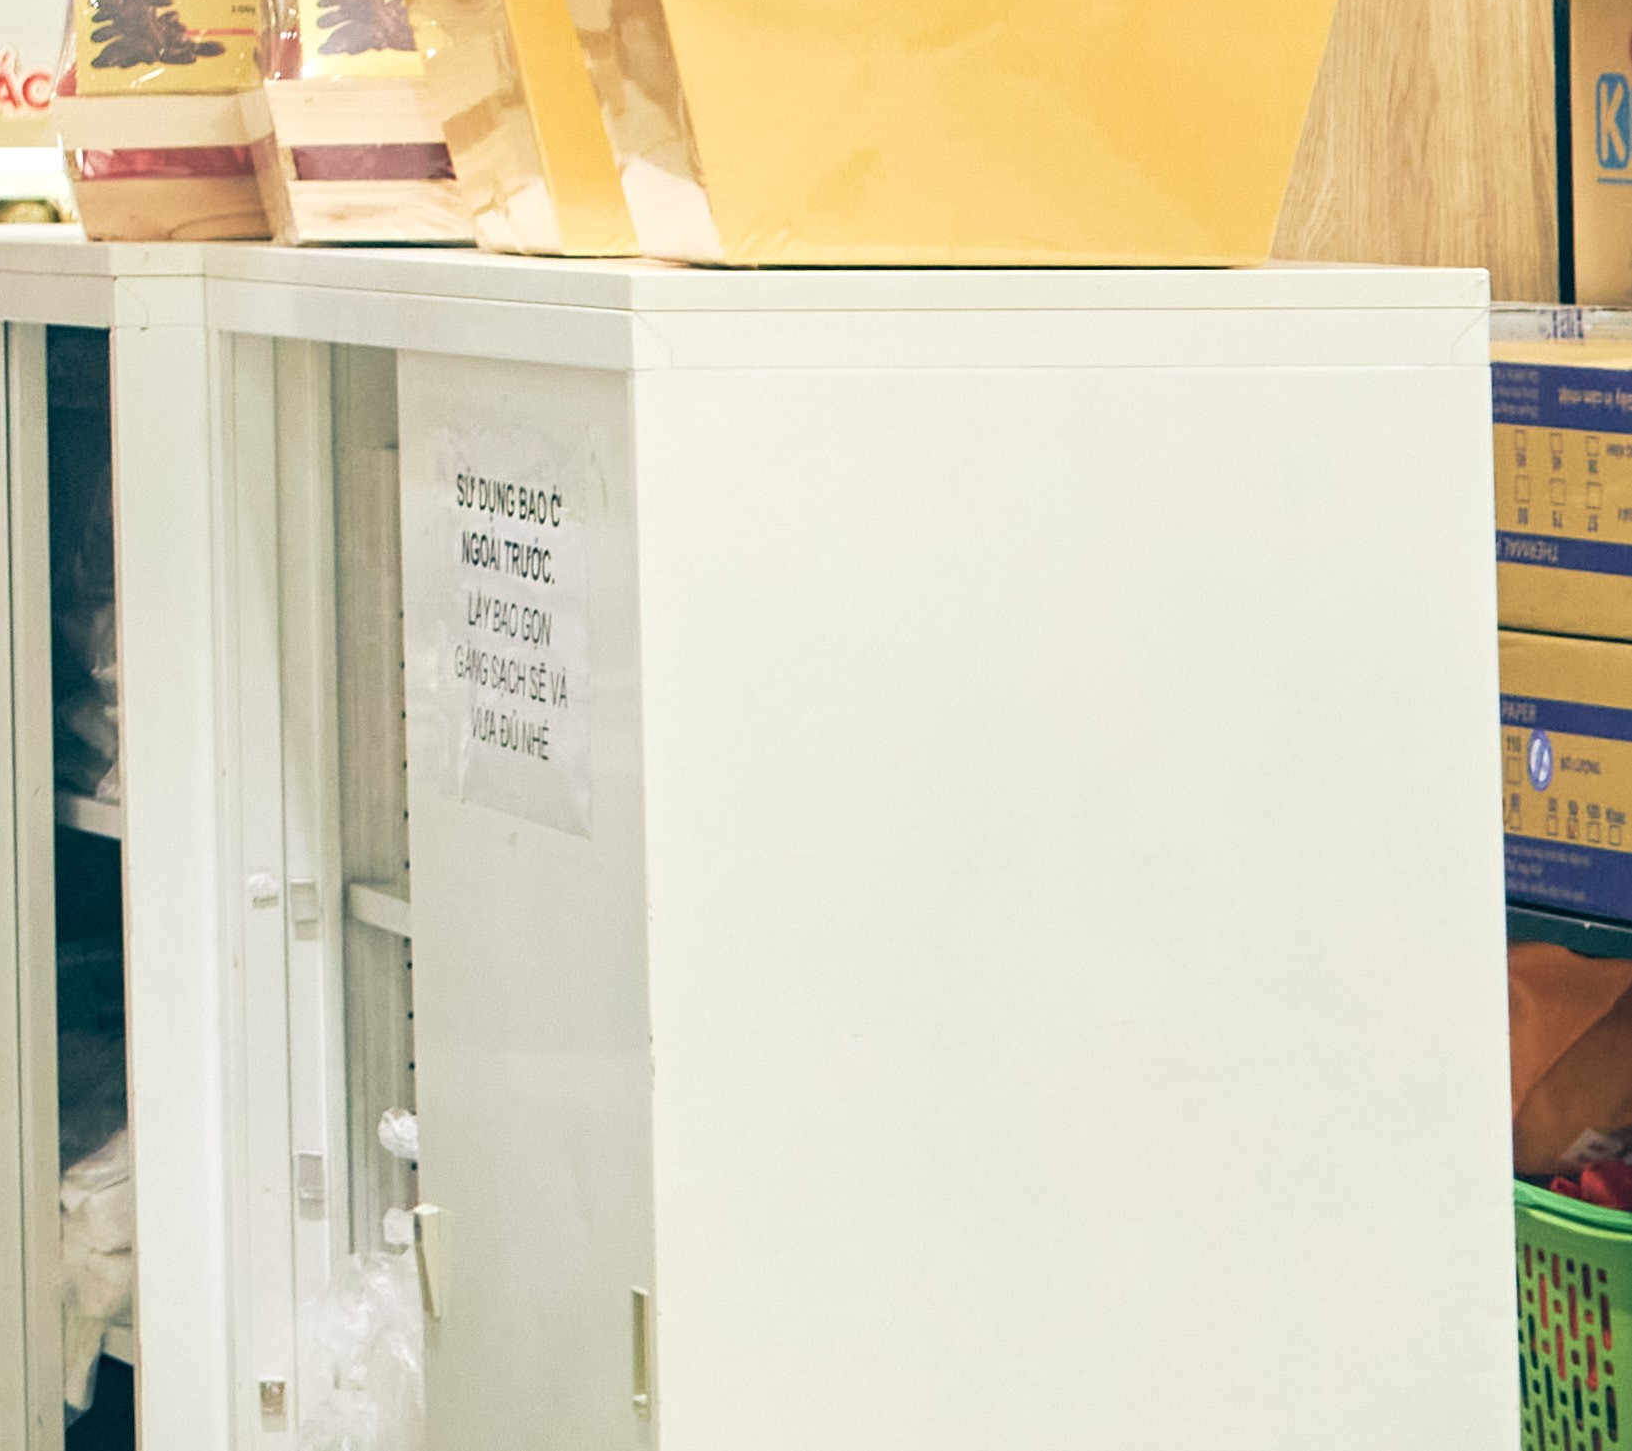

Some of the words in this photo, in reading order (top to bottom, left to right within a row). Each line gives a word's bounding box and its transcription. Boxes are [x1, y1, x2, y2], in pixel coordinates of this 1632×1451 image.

[478, 476, 516, 524] DỤNG
[518, 485, 548, 527] BAO
[492, 598, 519, 639] BAO
[520, 605, 553, 652] GỌN
[490, 653, 527, 698] SẠCH
[521, 719, 550, 762] NHÉ
